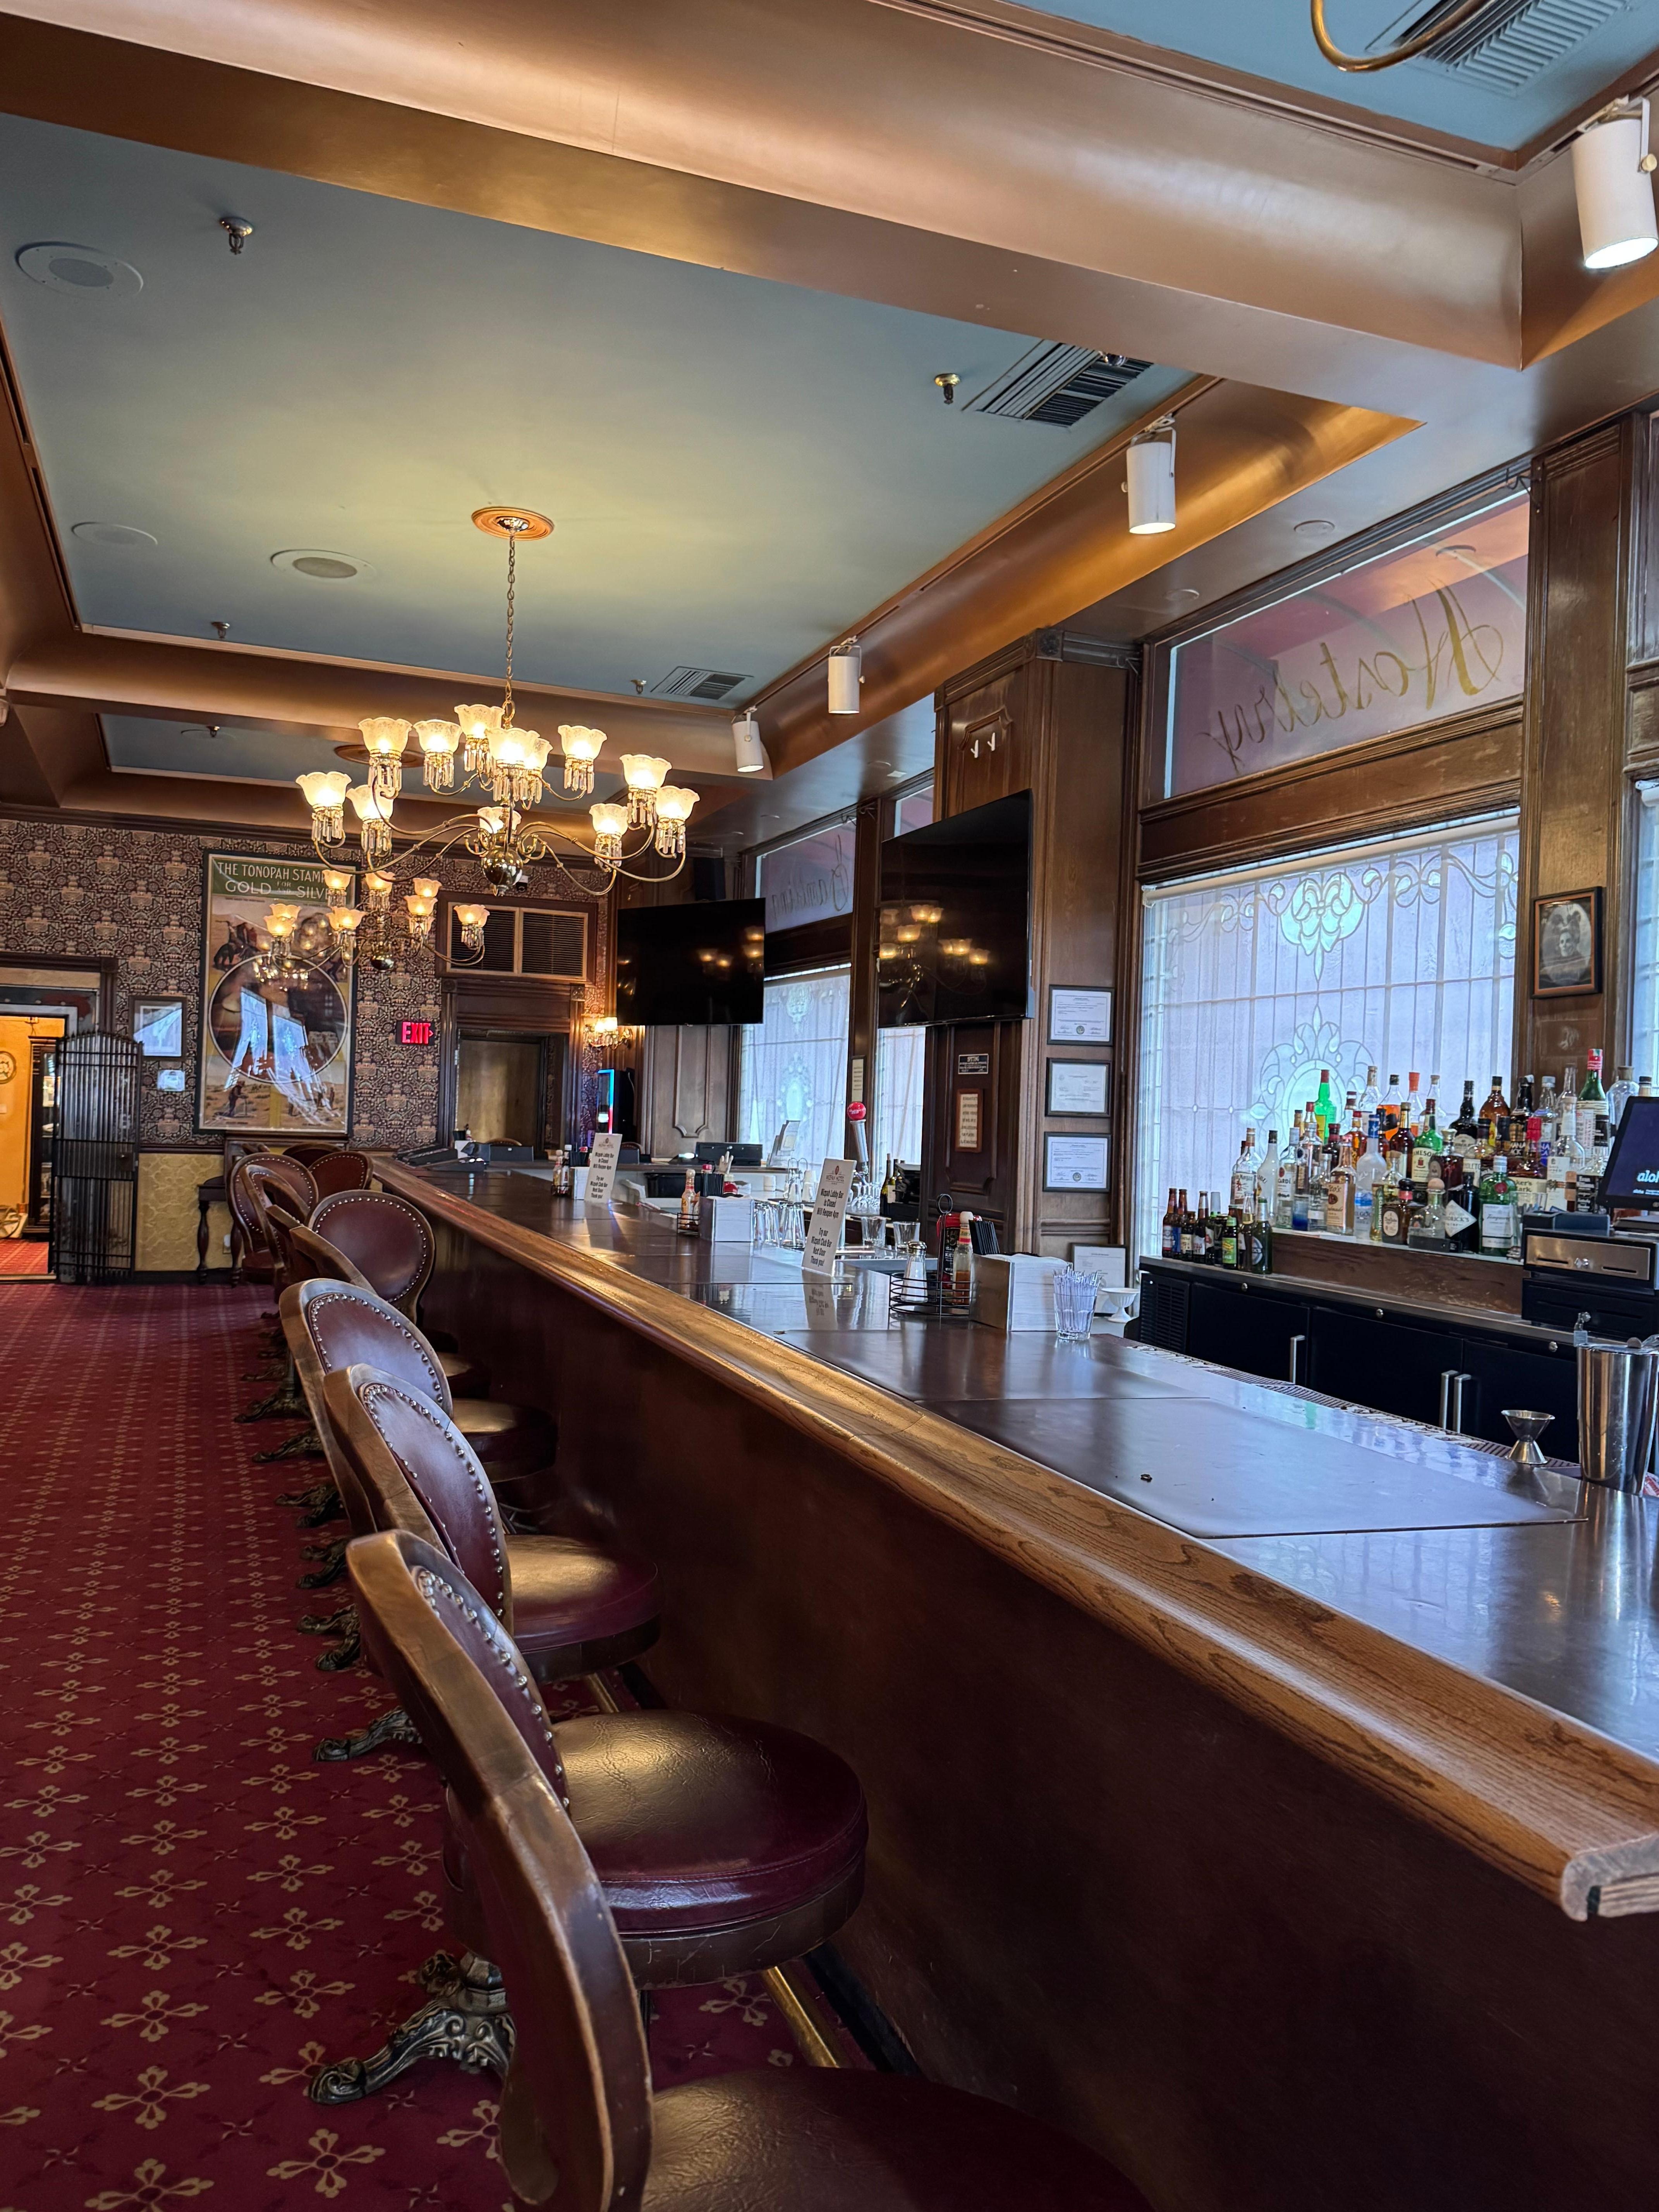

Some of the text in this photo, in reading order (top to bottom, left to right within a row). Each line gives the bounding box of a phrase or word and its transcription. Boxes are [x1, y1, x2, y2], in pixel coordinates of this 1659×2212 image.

[217, 862, 239, 876] THE
[242, 864, 289, 880] TONOPAH
[225, 880, 271, 895] GOLD
[402, 1022, 431, 1044] EXIT
[821, 1188, 830, 1197] Mizpah
[830, 1190, 838, 1199] Lobby
[826, 1199, 836, 1207] Closed
[823, 1208, 833, 1218] Reopen
[811, 1236, 821, 1246] Mizpah
